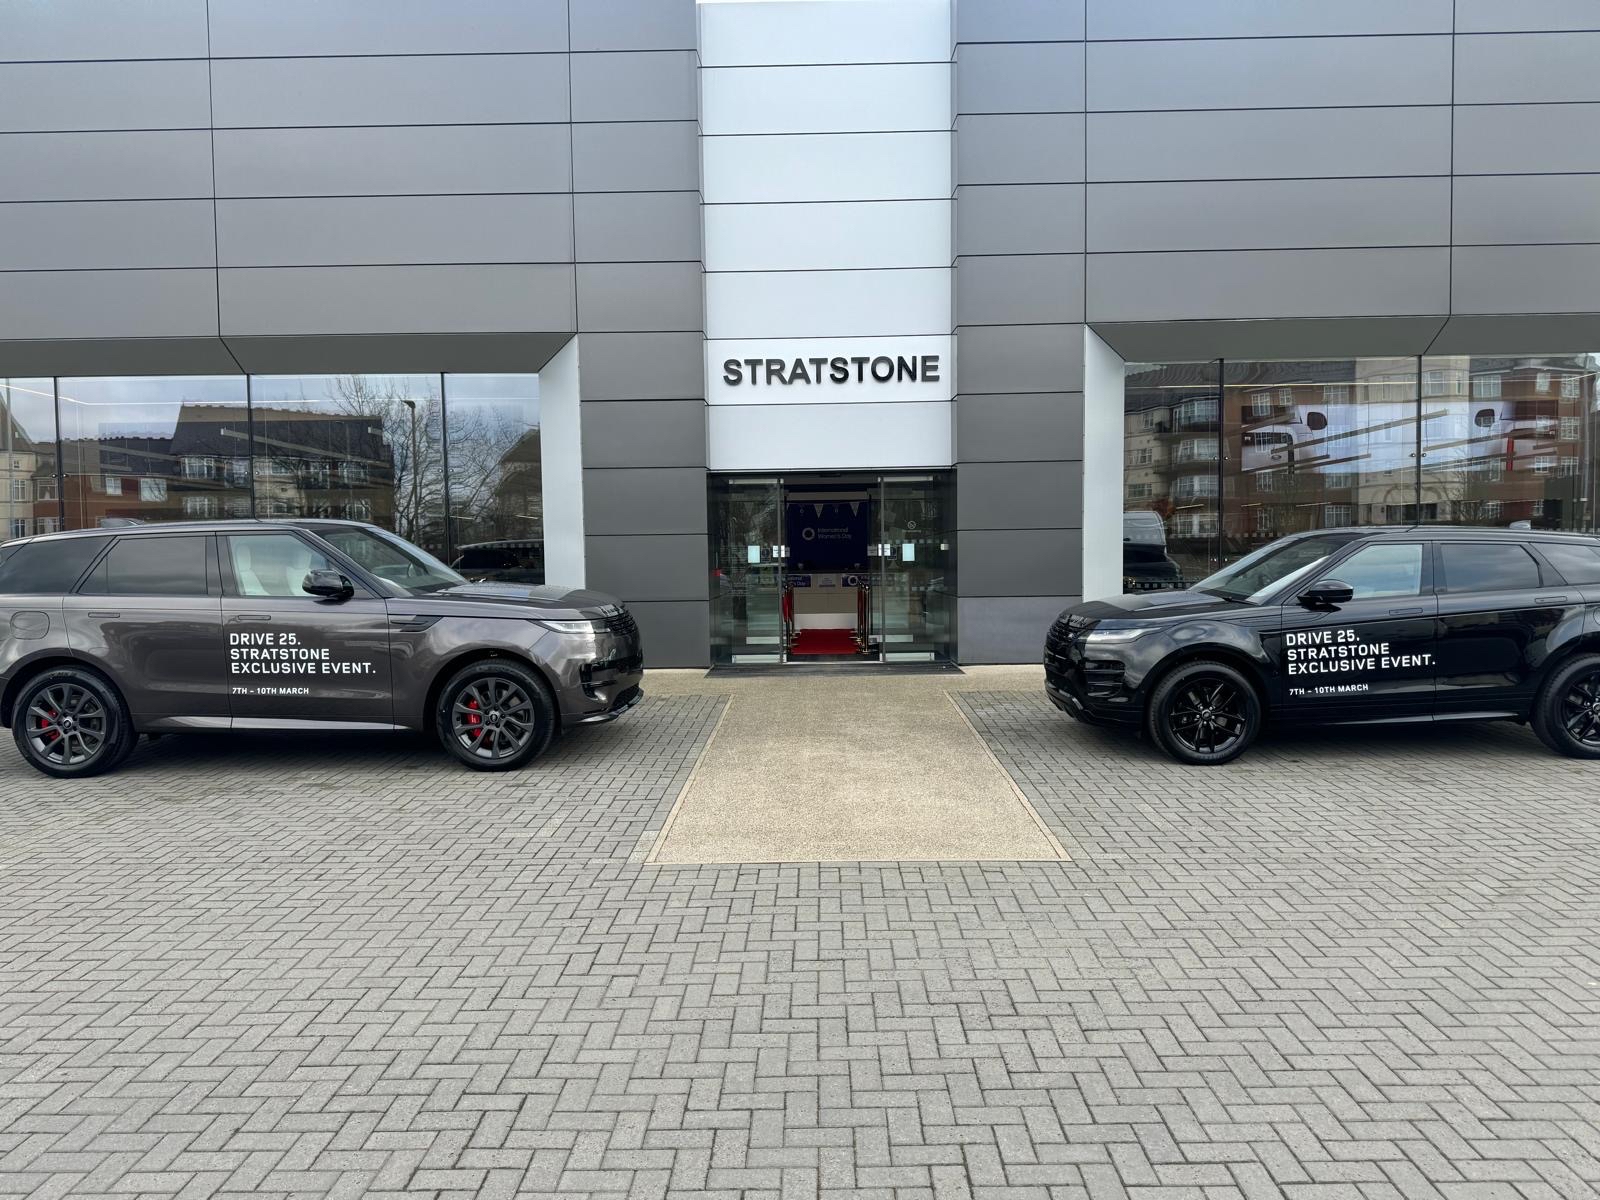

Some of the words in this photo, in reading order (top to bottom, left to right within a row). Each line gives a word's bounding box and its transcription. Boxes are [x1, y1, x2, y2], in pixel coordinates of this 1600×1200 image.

[723, 355, 940, 386] STRATSTONE
[229, 633, 274, 646] DRIVE
[279, 633, 301, 646] 25.
[1286, 631, 1332, 646] DRIVE
[1337, 629, 1360, 643] 25.
[230, 648, 330, 660] STRATSTONE
[1287, 643, 1390, 661] STRATSTONE
[231, 662, 316, 674] EXCLUSIVE
[321, 662, 376, 674] EVENT.
[1288, 658, 1376, 675] EXCLUSIVE
[1381, 653, 1436, 669] EVENT.
[232, 687, 248, 695] 7TH
[257, 687, 277, 695] 10TH
[279, 687, 310, 695] MARCH
[1289, 688, 1305, 696] 7TH
[1315, 686, 1335, 694] 10TH
[1338, 683, 1369, 693] MARCH
